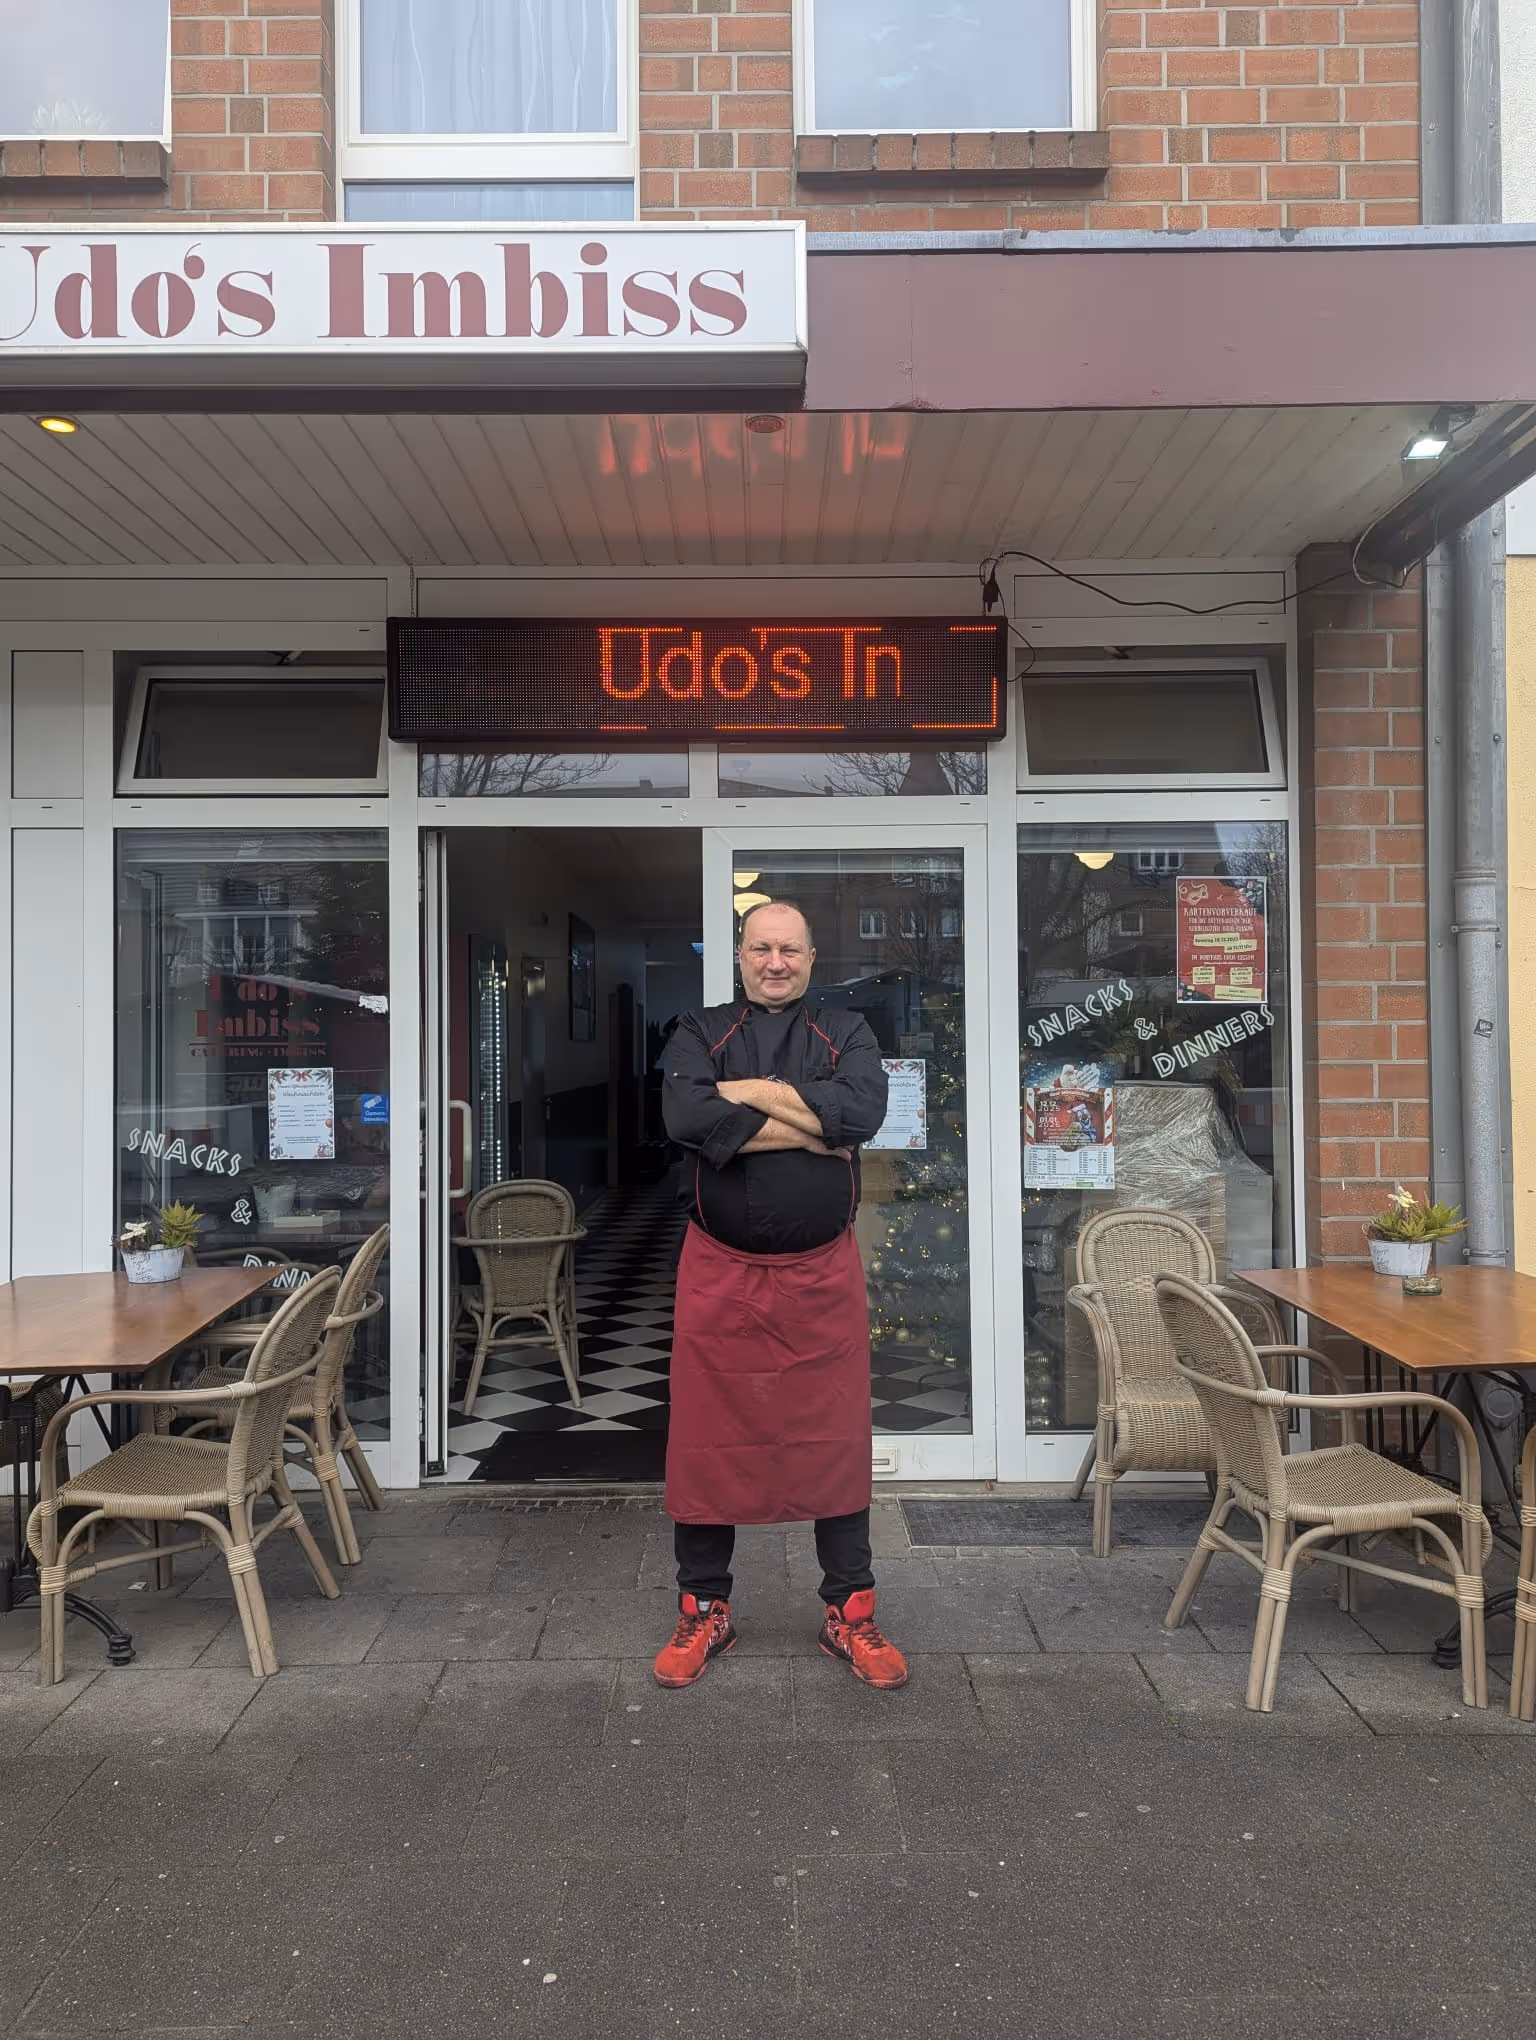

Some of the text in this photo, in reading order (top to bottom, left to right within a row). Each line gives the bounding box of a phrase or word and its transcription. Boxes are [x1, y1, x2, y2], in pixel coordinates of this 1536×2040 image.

[317, 242, 748, 338] Imbiss
[1027, 979, 1134, 1047] SNACKS
[1134, 1017, 1158, 1040] &
[1152, 1003, 1275, 1079] DINNERS
[128, 1127, 242, 1177] SNACKS
[230, 1198, 252, 1225] &
